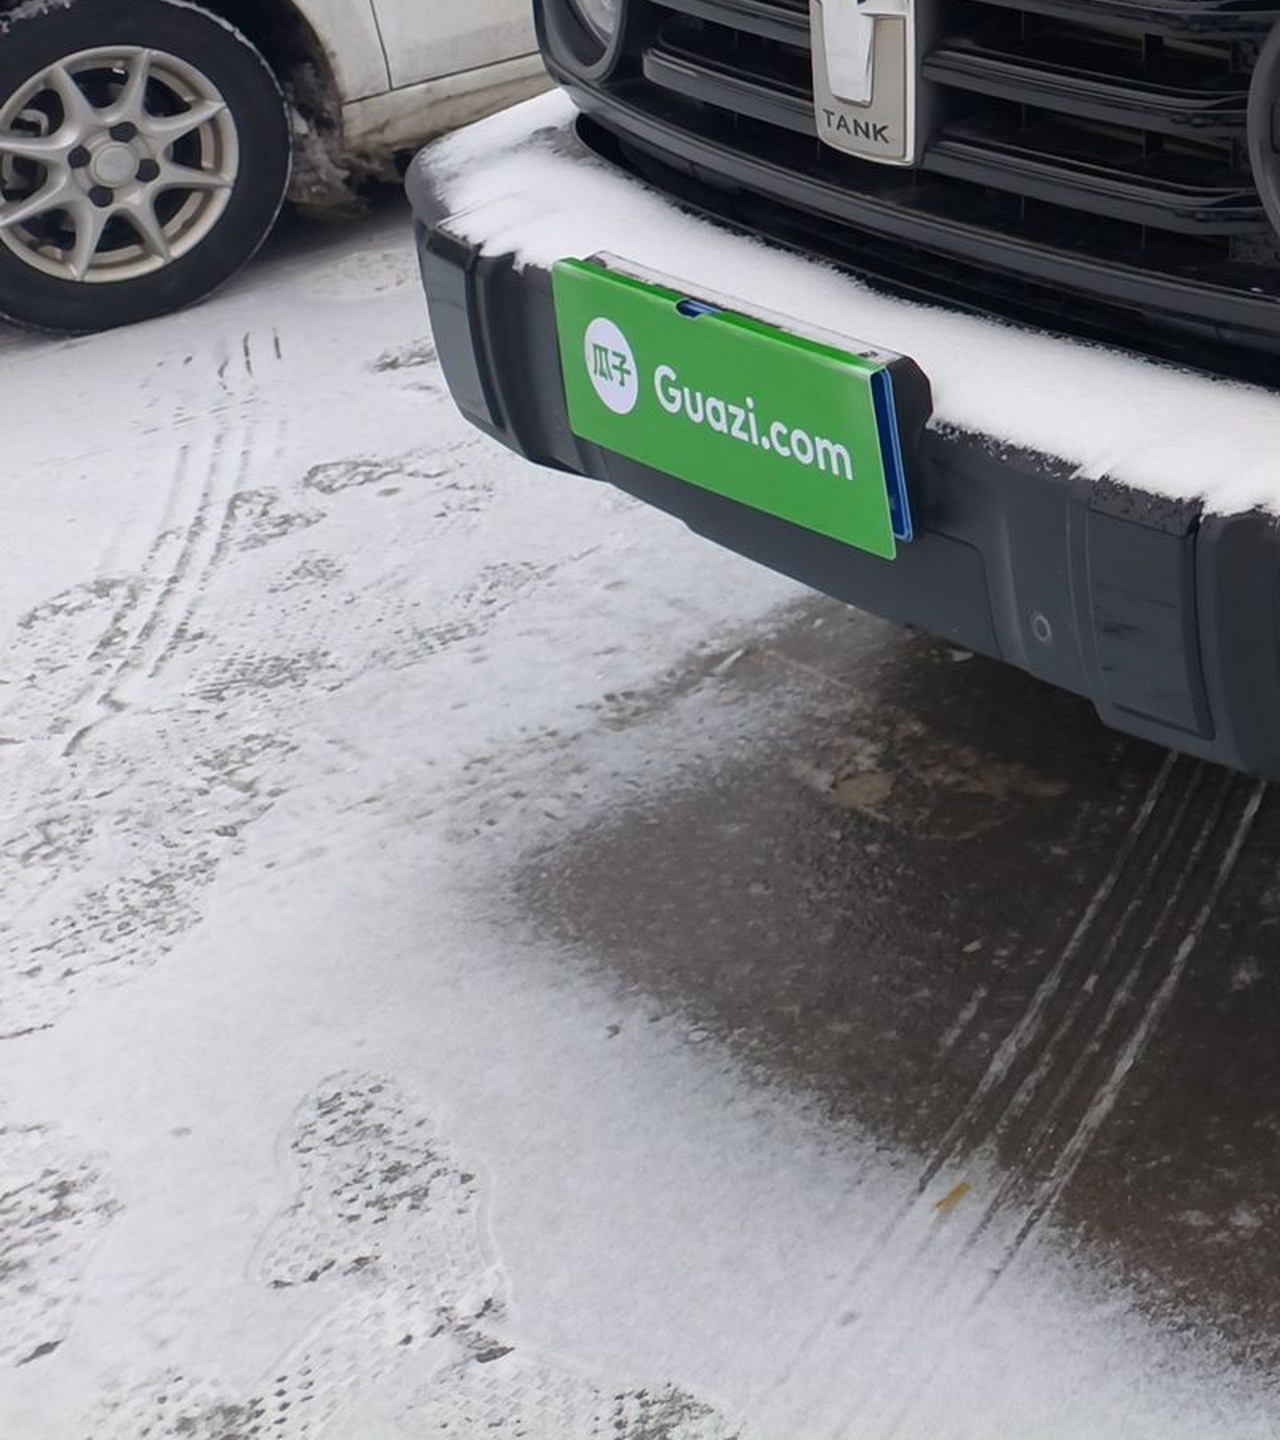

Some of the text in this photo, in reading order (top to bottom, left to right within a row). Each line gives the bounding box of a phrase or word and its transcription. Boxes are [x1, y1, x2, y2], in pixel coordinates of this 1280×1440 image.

[822, 108, 889, 144] TANK
[592, 343, 631, 387] 瓜子
[654, 364, 854, 481] Guazi.com
